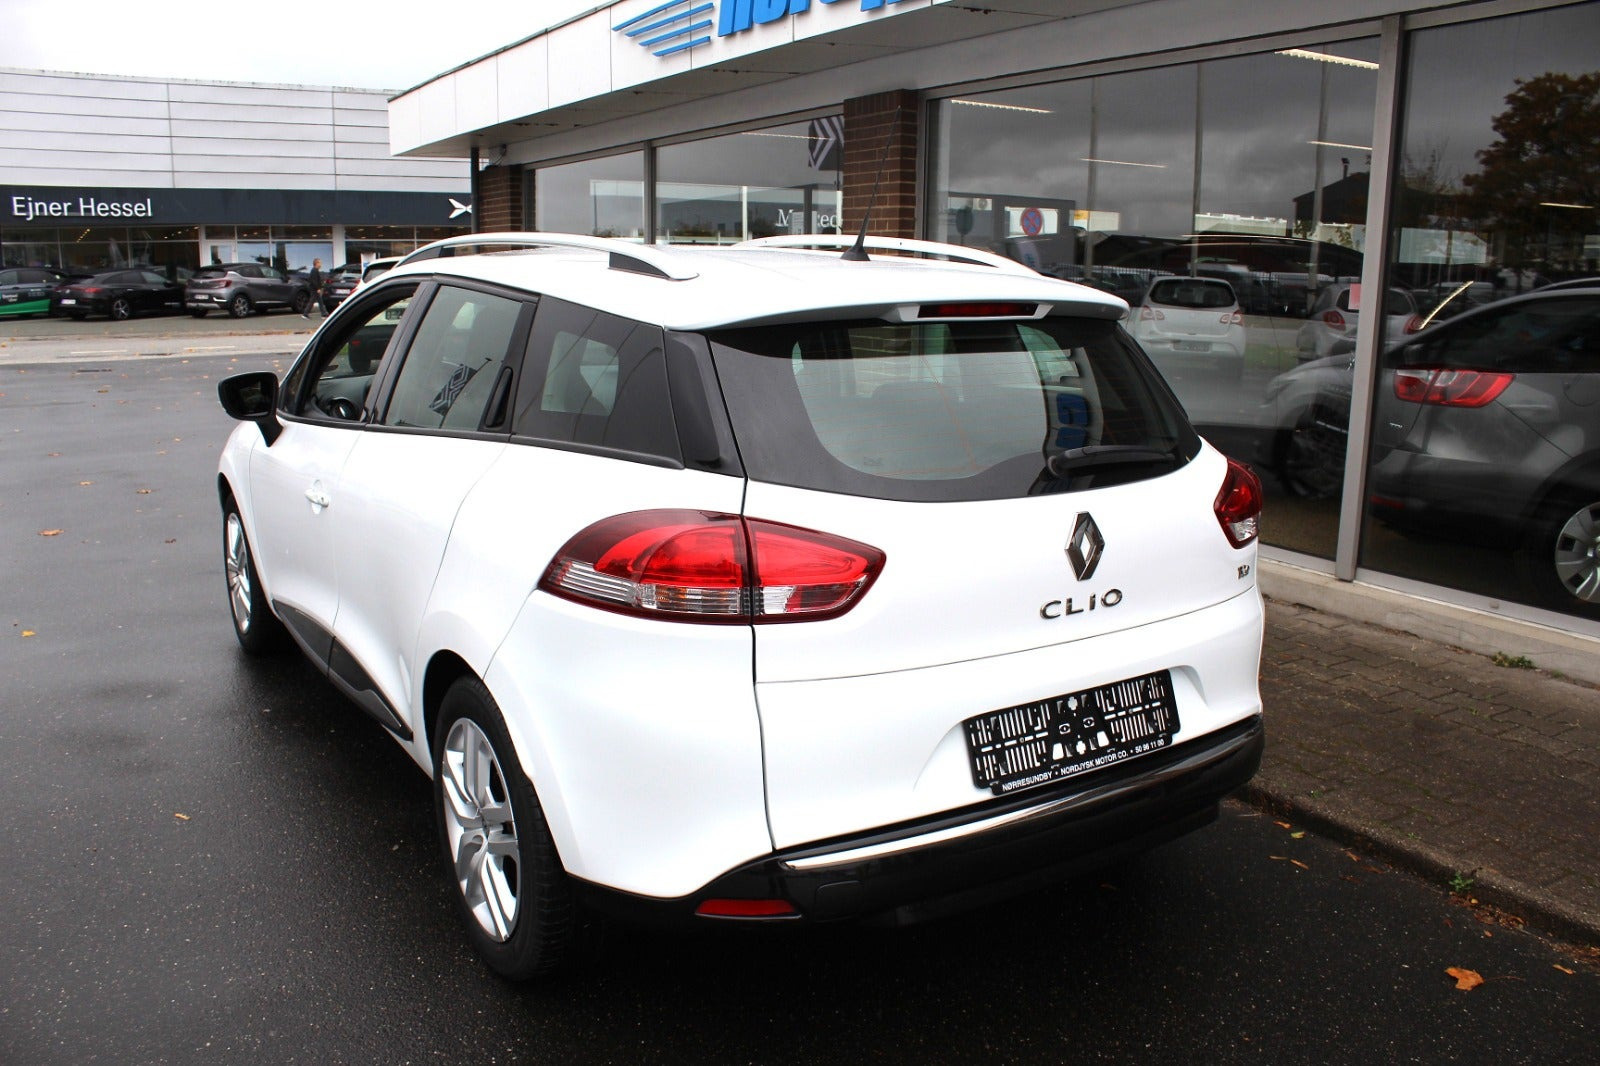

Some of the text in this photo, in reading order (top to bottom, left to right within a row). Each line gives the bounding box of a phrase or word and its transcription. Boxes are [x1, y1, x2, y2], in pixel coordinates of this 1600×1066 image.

[12, 196, 152, 221] Ejner Hessel
[1040, 588, 1123, 619] CLIO
[1060, 760, 1095, 776] NORDJYSK
[1095, 754, 1117, 768] MOTOR
[1117, 750, 1129, 760] CO.
